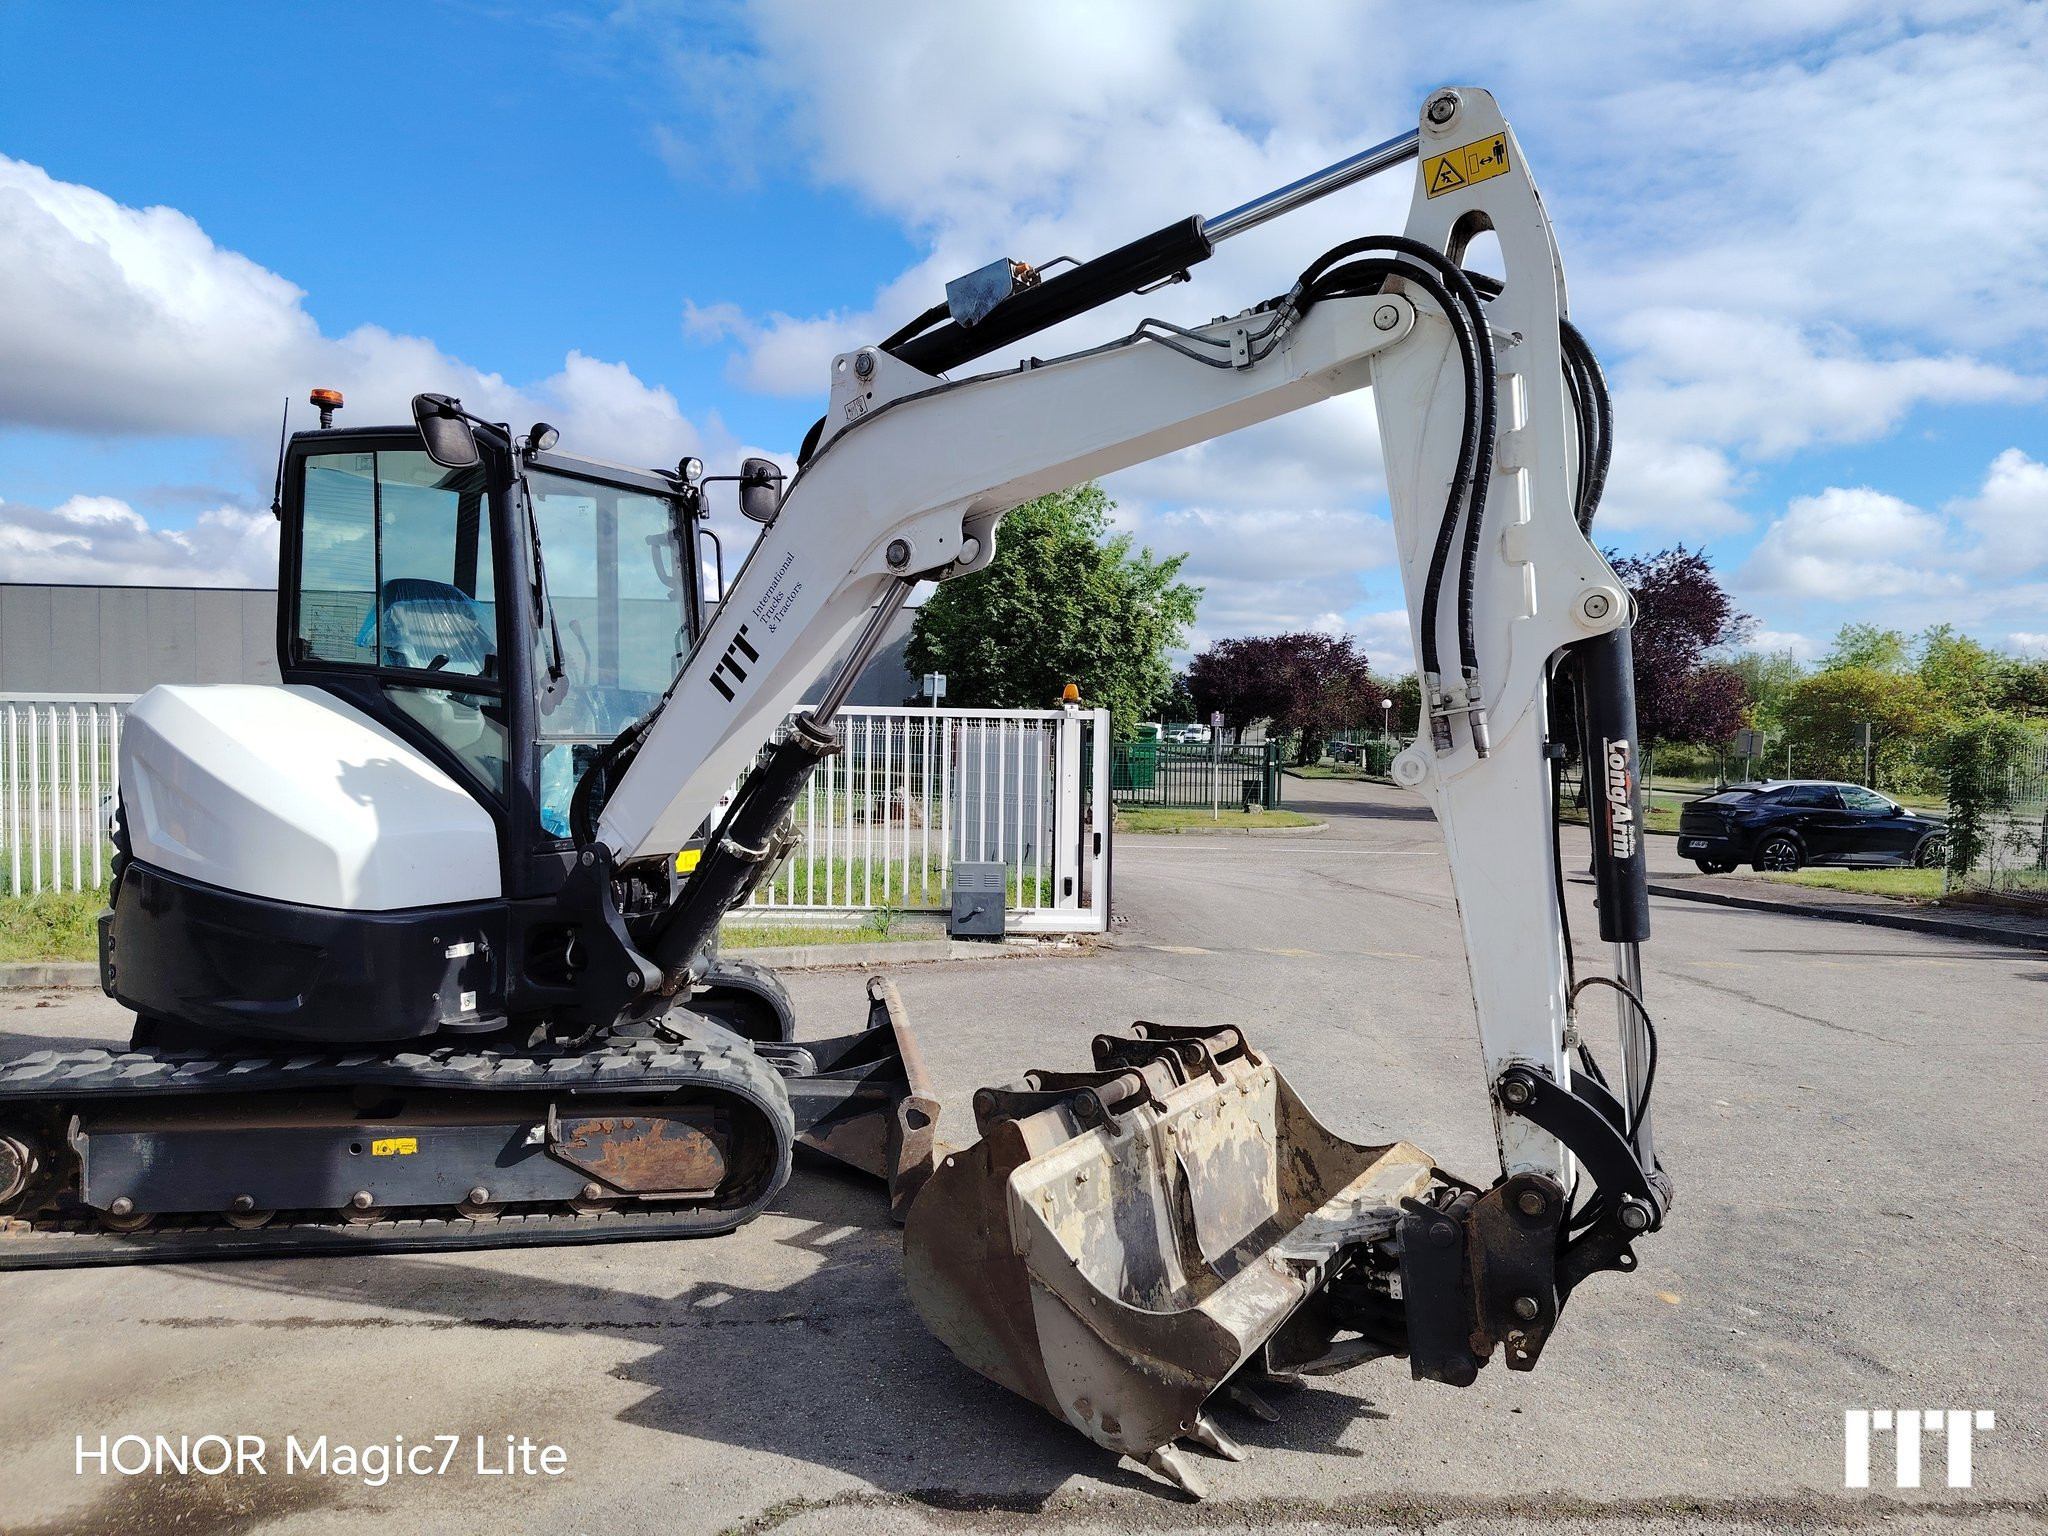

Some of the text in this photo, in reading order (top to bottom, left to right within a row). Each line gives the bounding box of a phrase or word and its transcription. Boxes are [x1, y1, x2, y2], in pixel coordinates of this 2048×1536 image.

[752, 551, 795, 618] International
[759, 591, 784, 625] Trucks
[768, 581, 803, 634] & Tractors
[1215, 714, 1221, 722] 2
[1605, 738, 1633, 859] LongArm
